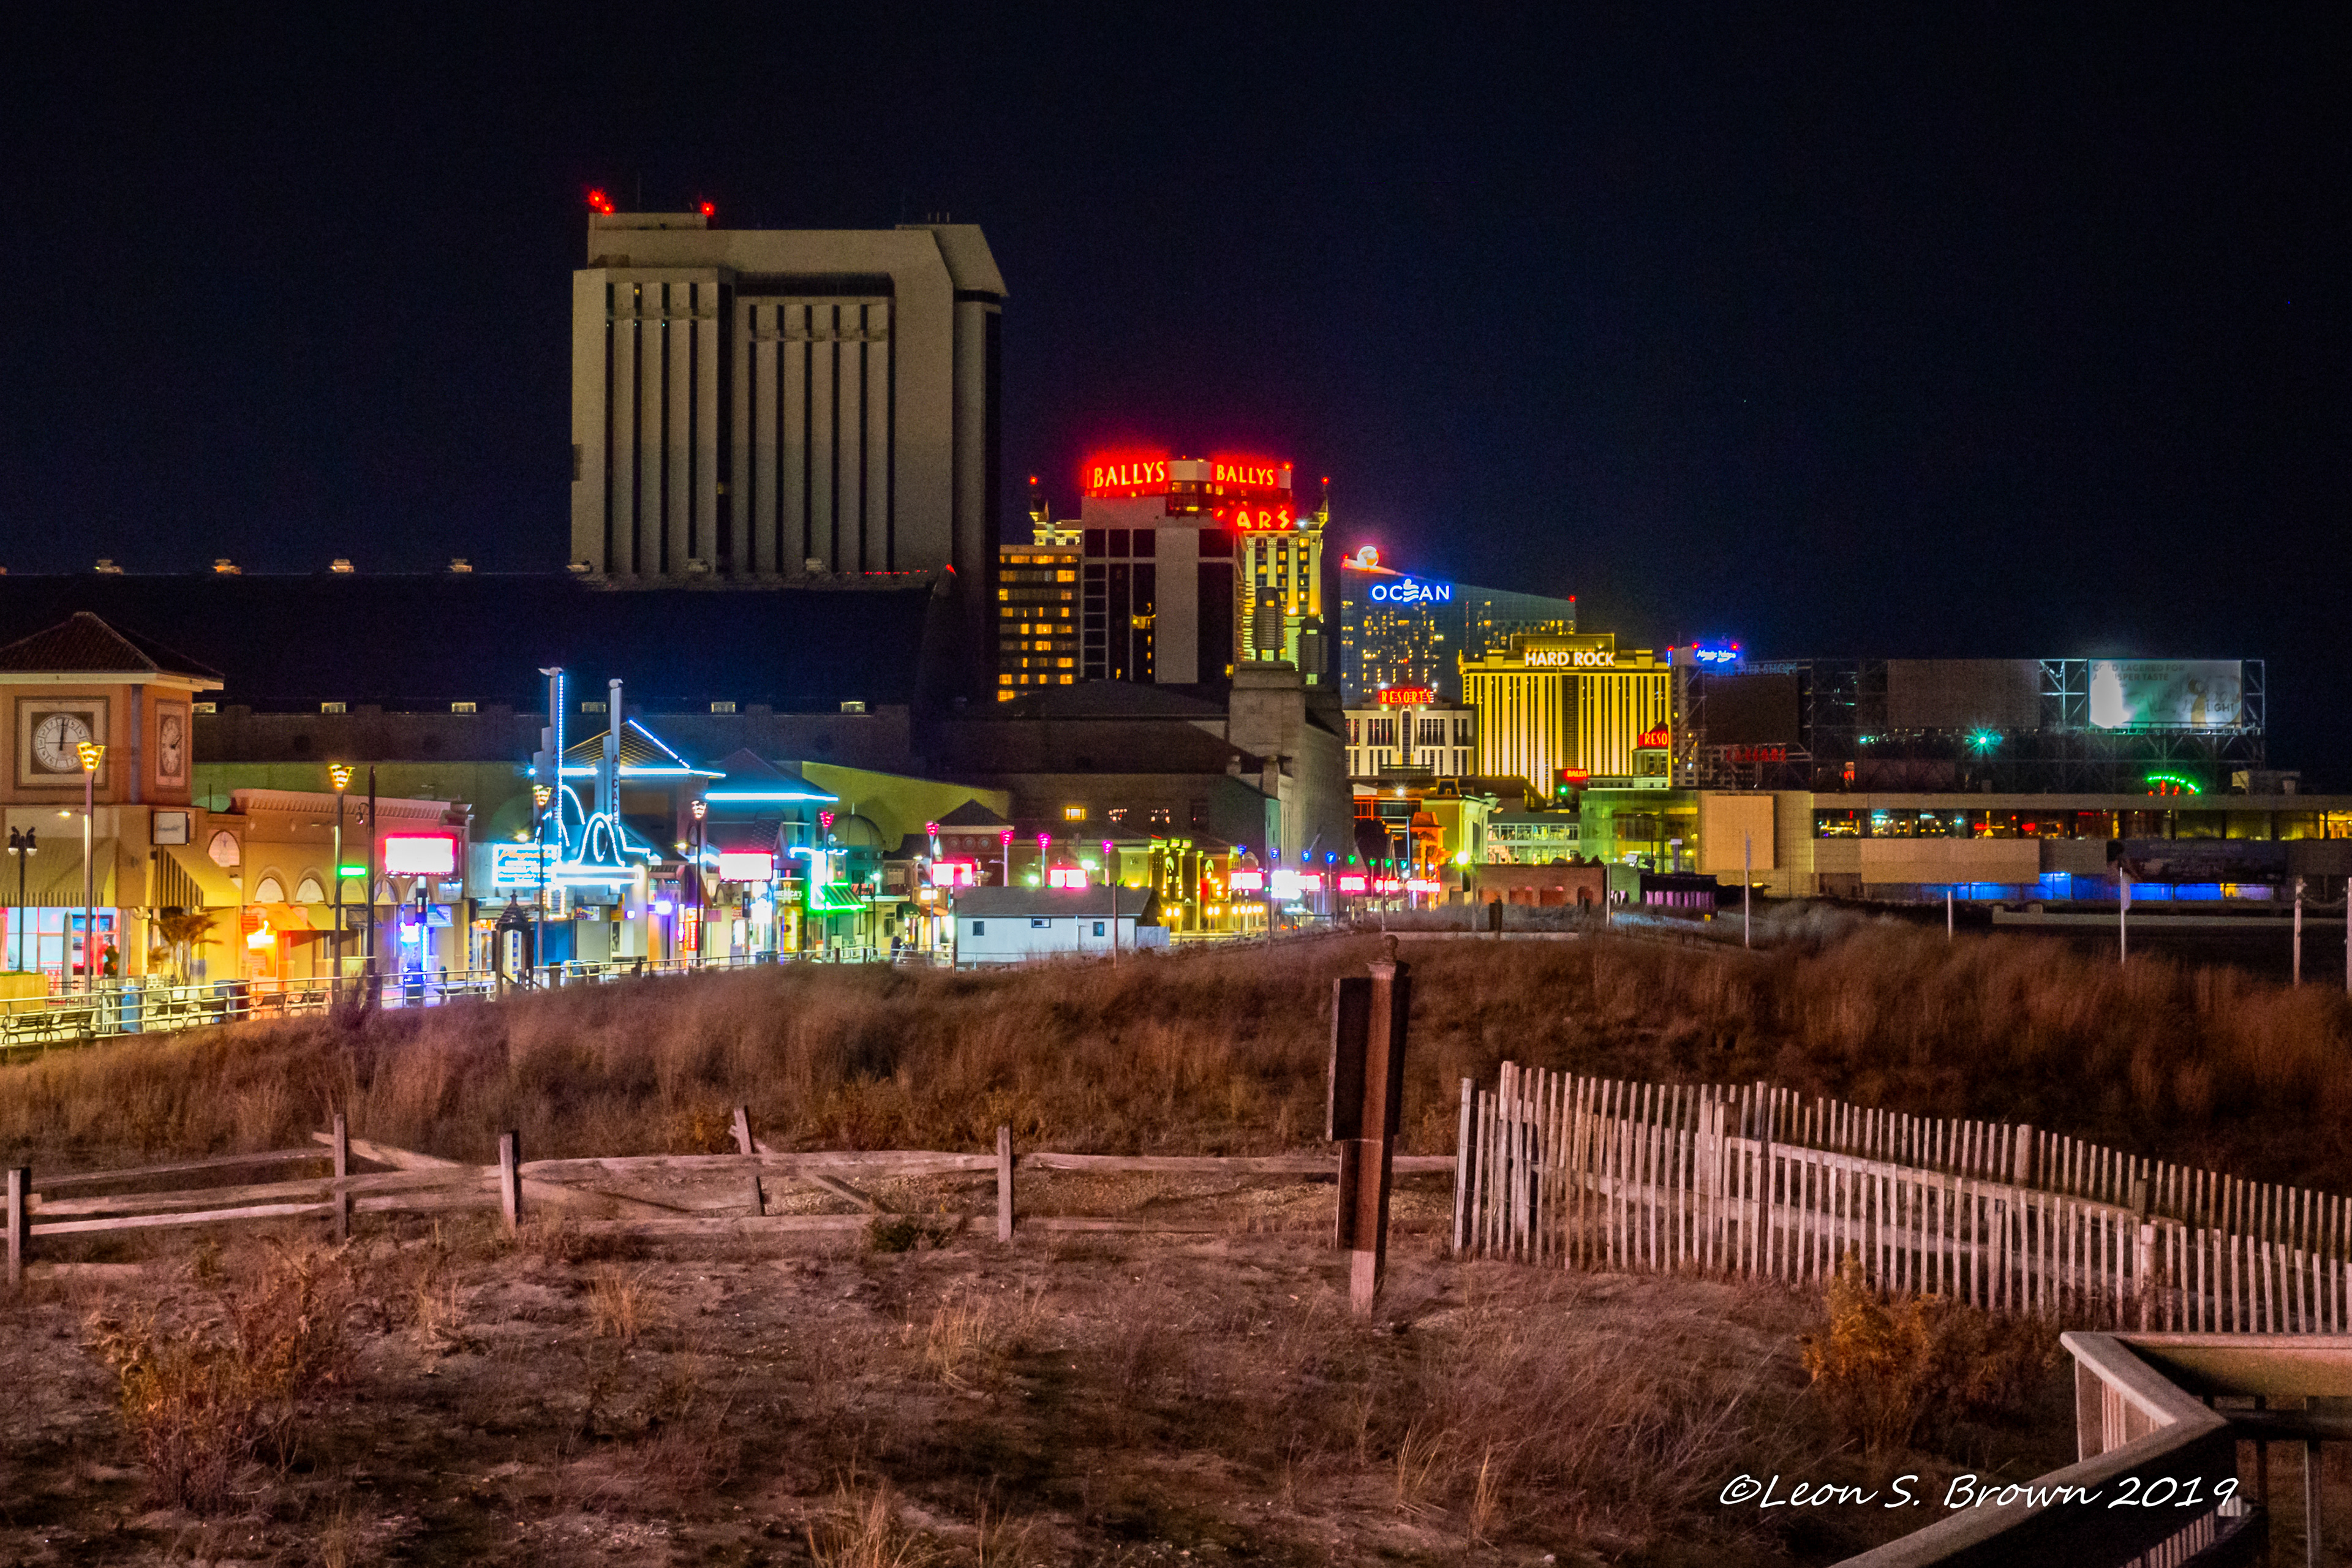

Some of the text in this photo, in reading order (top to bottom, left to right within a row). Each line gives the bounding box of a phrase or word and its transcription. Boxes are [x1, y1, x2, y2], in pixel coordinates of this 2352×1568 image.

[1093, 461, 1164, 488] BALLYS
[1216, 464, 1274, 486] BALLYS
[1217, 510, 1290, 529] ARS
[1372, 578, 1449, 602] OCEAN
[1525, 652, 1616, 666] HARD ROCK
[1381, 691, 1431, 703] RESORTS
[1645, 733, 1668, 745] RESO
